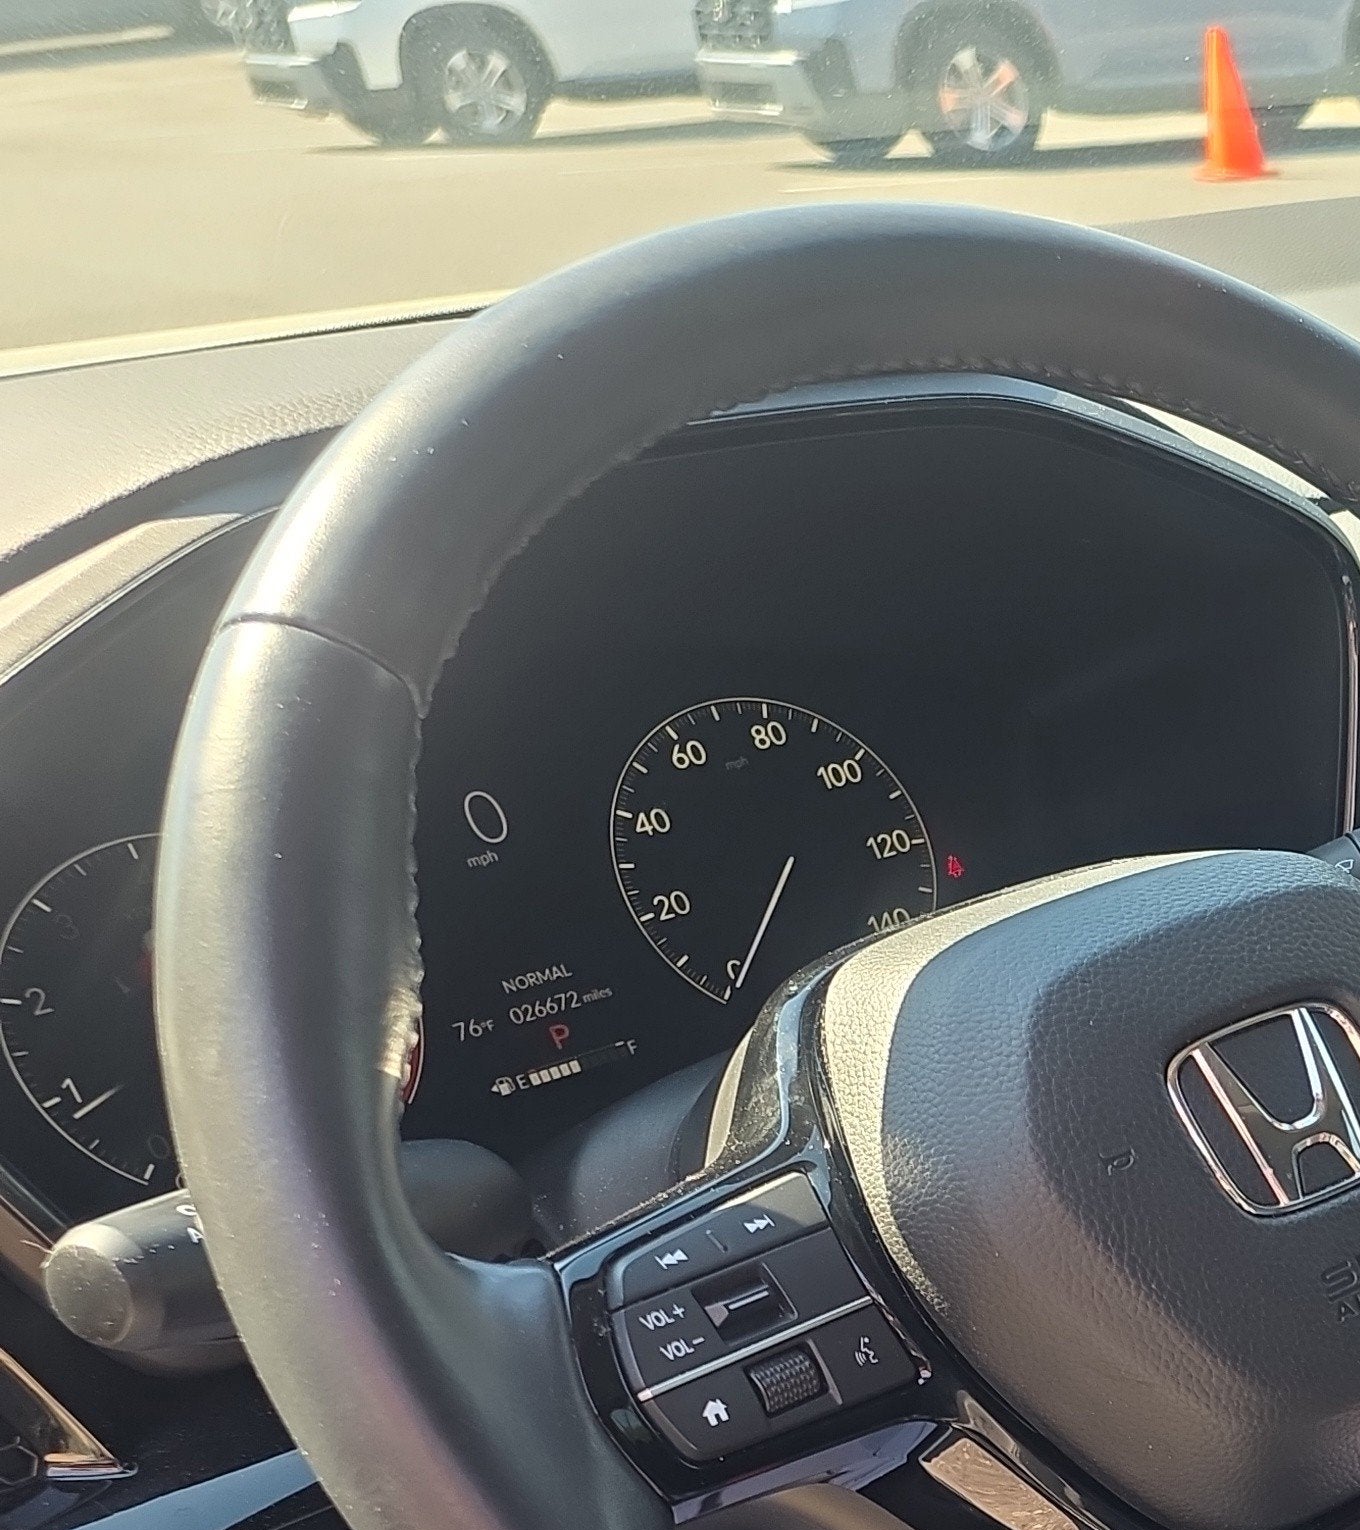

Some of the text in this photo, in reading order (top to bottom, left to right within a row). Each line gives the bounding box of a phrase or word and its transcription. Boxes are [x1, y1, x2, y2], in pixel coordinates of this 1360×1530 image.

[750, 720, 787, 751] 80
[671, 739, 707, 771] 60
[816, 759, 862, 790] 100
[464, 790, 508, 843] 0
[635, 808, 671, 837] 40
[466, 849, 499, 869] mph
[866, 829, 911, 860] 120
[653, 890, 691, 921] 20
[501, 963, 573, 994] NORMAL
[24, 987, 54, 1016] 2
[508, 986, 613, 1025] 026672 miles
[548, 1022, 570, 1050] P
[626, 1038, 638, 1056] F
[61, 1078, 82, 1104] 1
[515, 1073, 530, 1090] E
